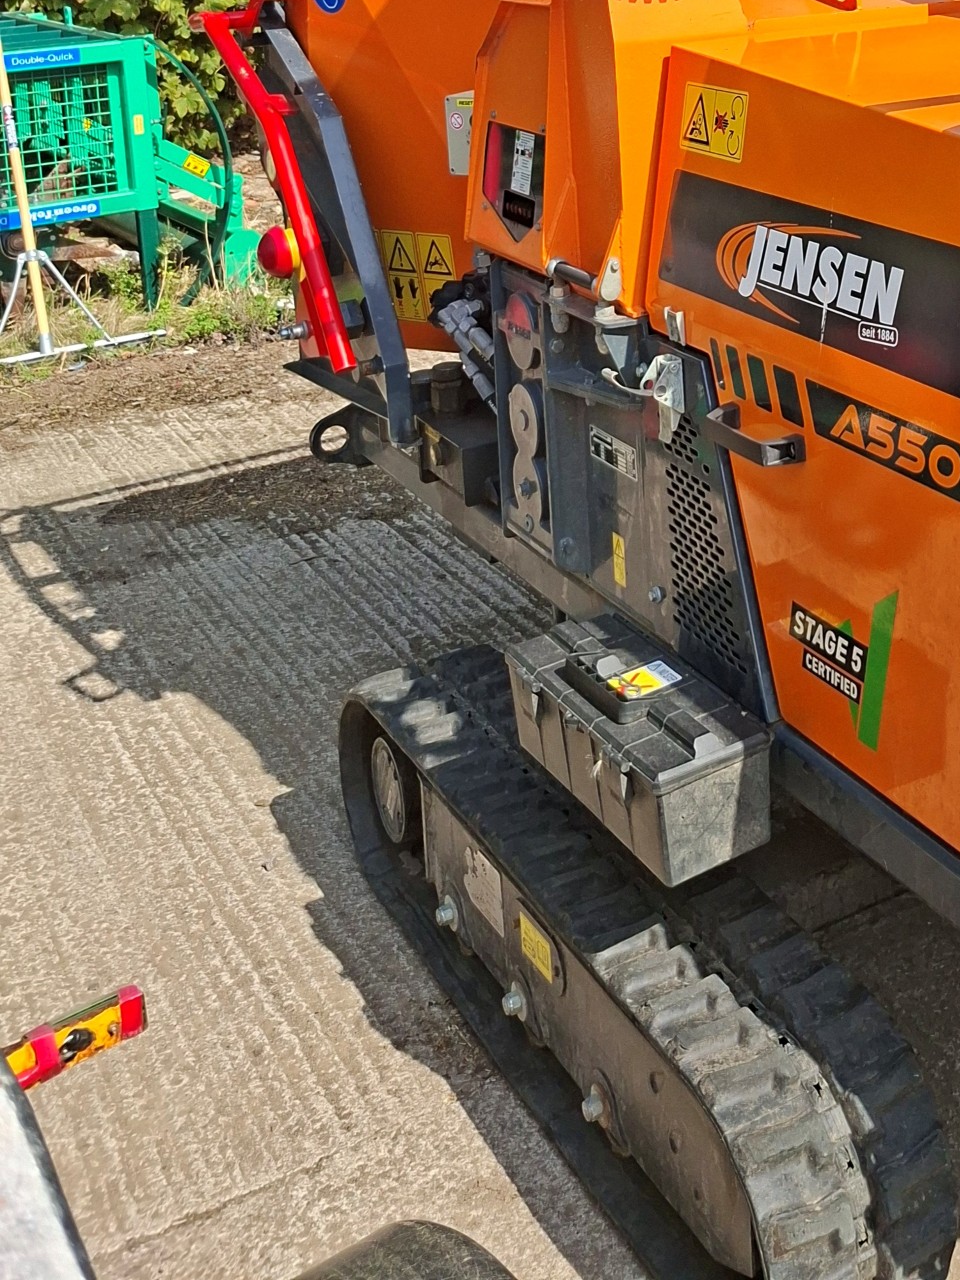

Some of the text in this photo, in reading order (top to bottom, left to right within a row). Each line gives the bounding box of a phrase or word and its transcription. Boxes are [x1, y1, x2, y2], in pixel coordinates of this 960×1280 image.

[11, 52, 74, 66] Double-Quick
[737, 223, 904, 326] JENSEN
[861, 326, 895, 343] seit 1884
[793, 610, 864, 673] STAGE 5
[804, 652, 858, 700] CERTIFIED
